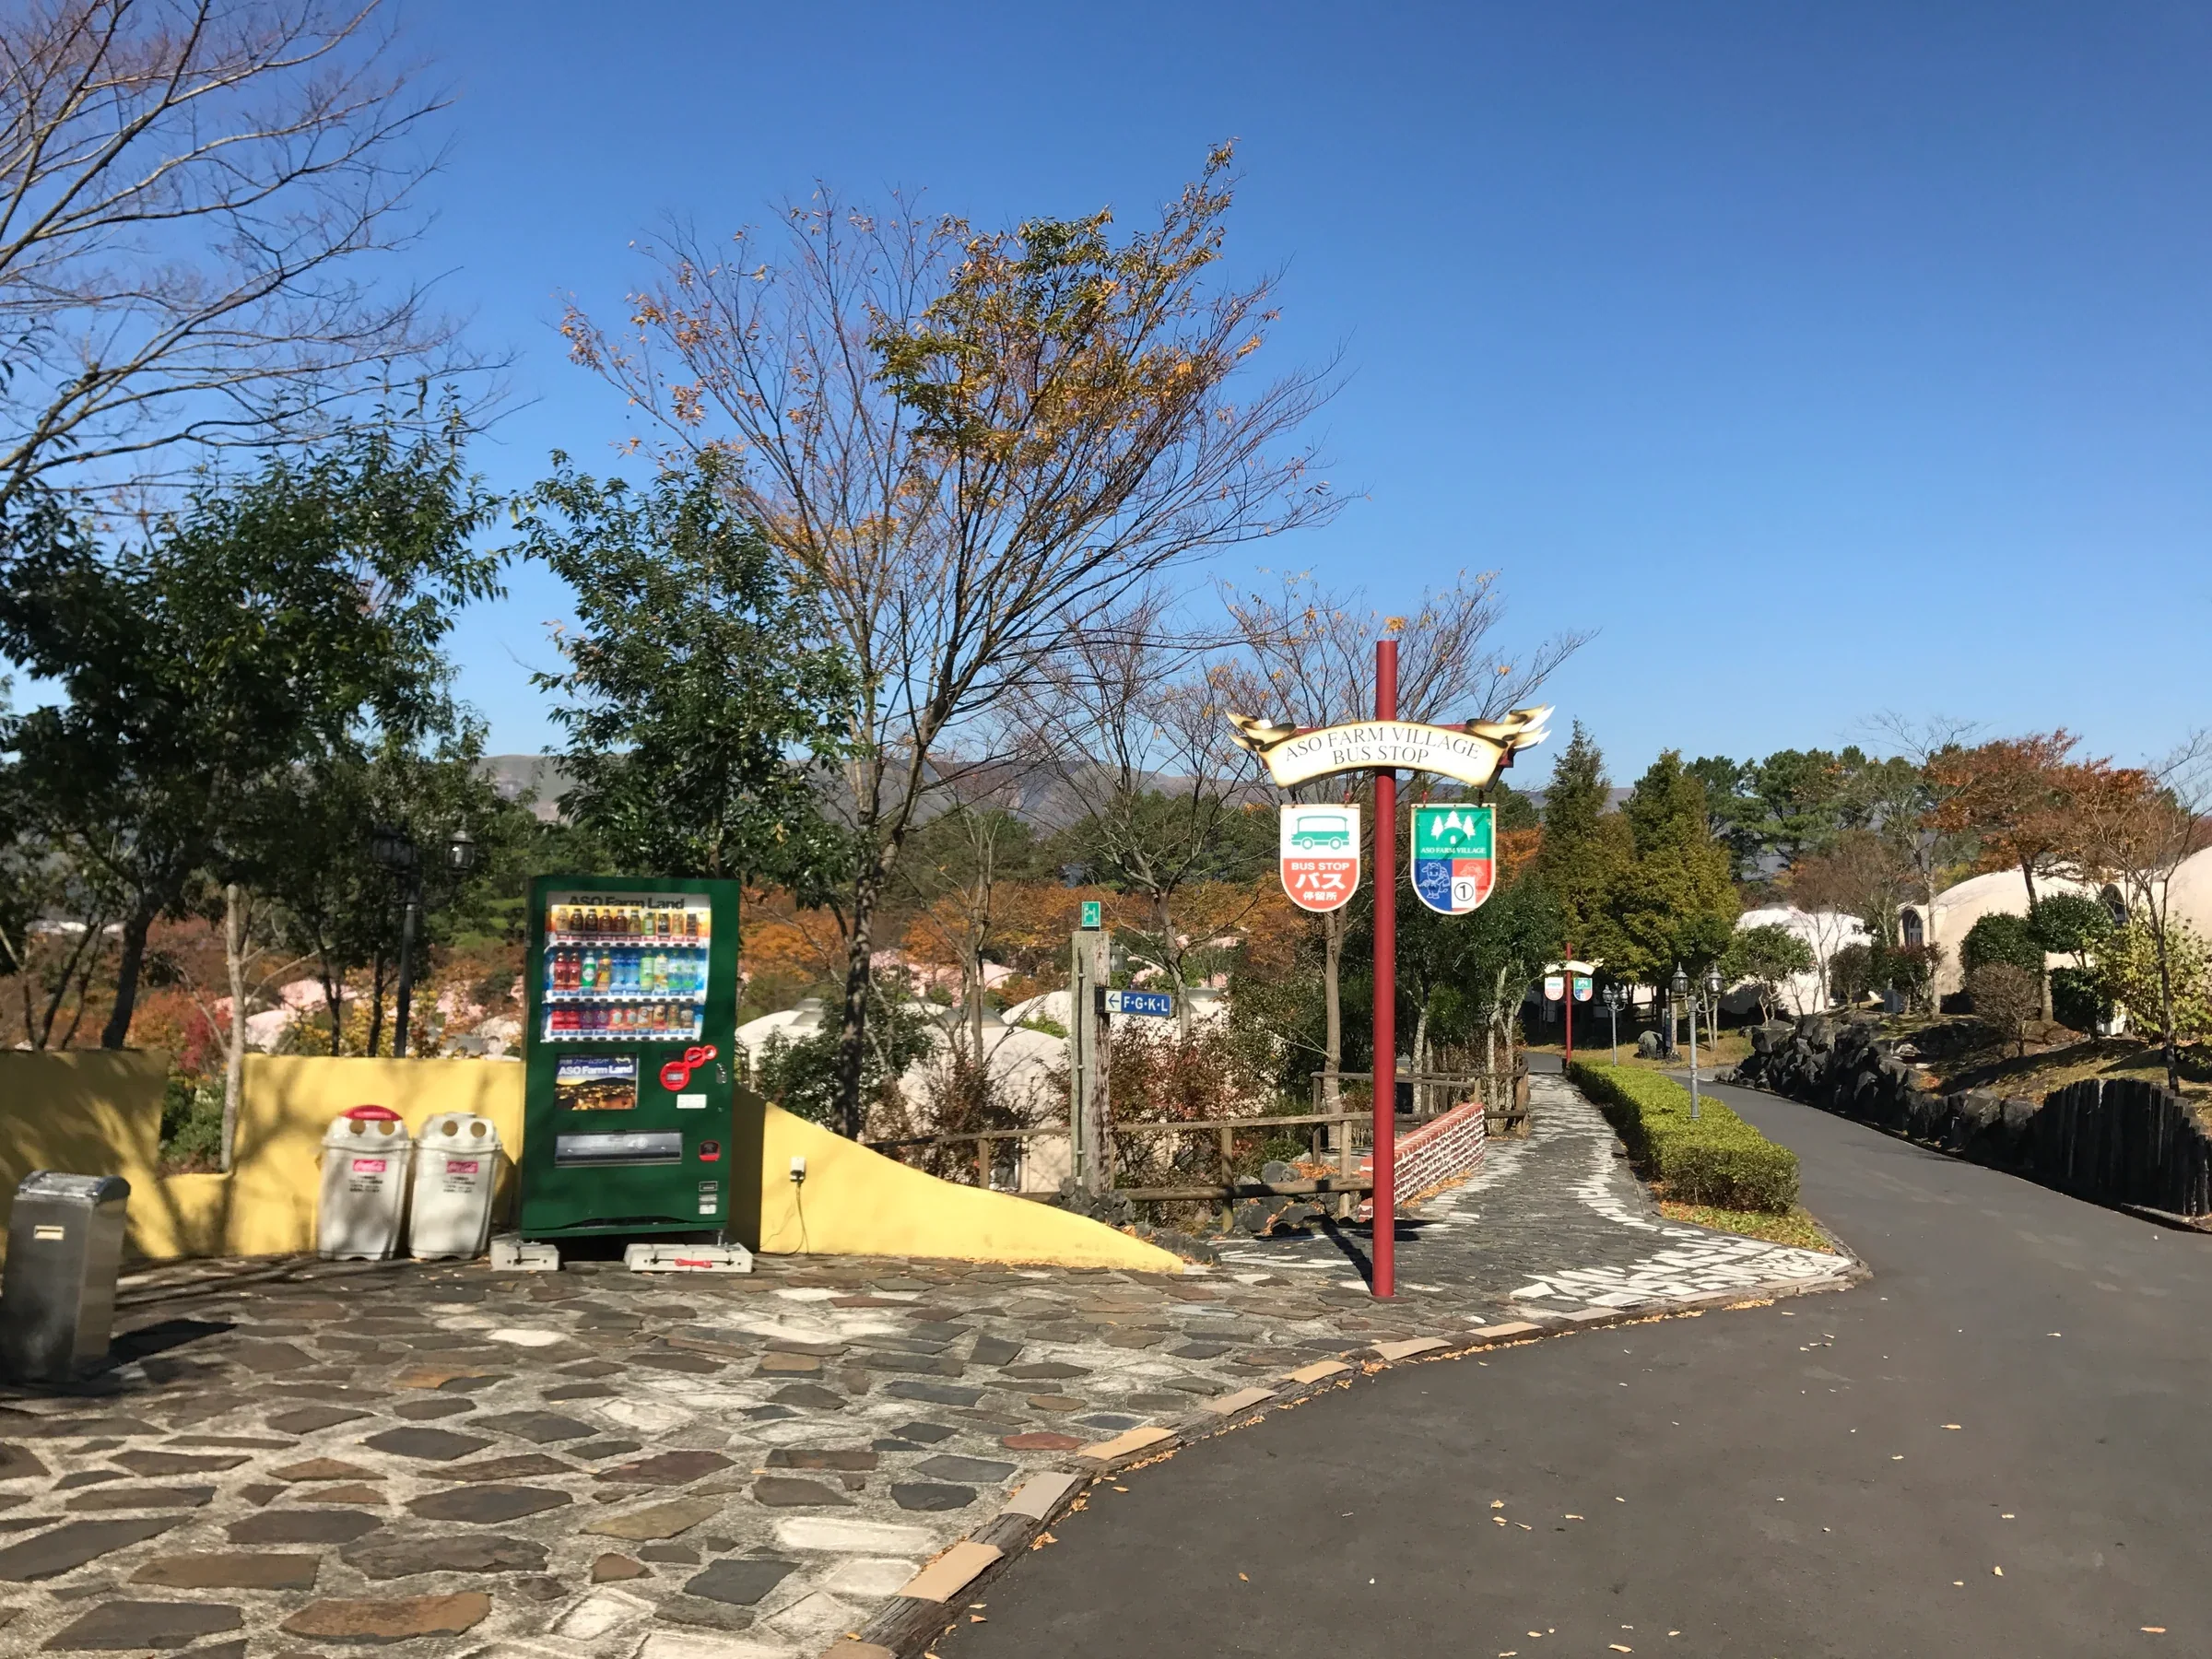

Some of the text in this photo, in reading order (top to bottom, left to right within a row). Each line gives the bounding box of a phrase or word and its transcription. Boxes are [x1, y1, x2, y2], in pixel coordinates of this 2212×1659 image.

[1286, 726, 1481, 761] ASO FARM VILLAGE
[1333, 745, 1429, 765] BUS STOP
[1291, 862, 1350, 871] BUS STOP
[1295, 872, 1346, 889] バス
[1303, 891, 1337, 900] 停留所
[569, 896, 685, 909] ASO Farm Land
[558, 1065, 633, 1075] ASO Farm Land
